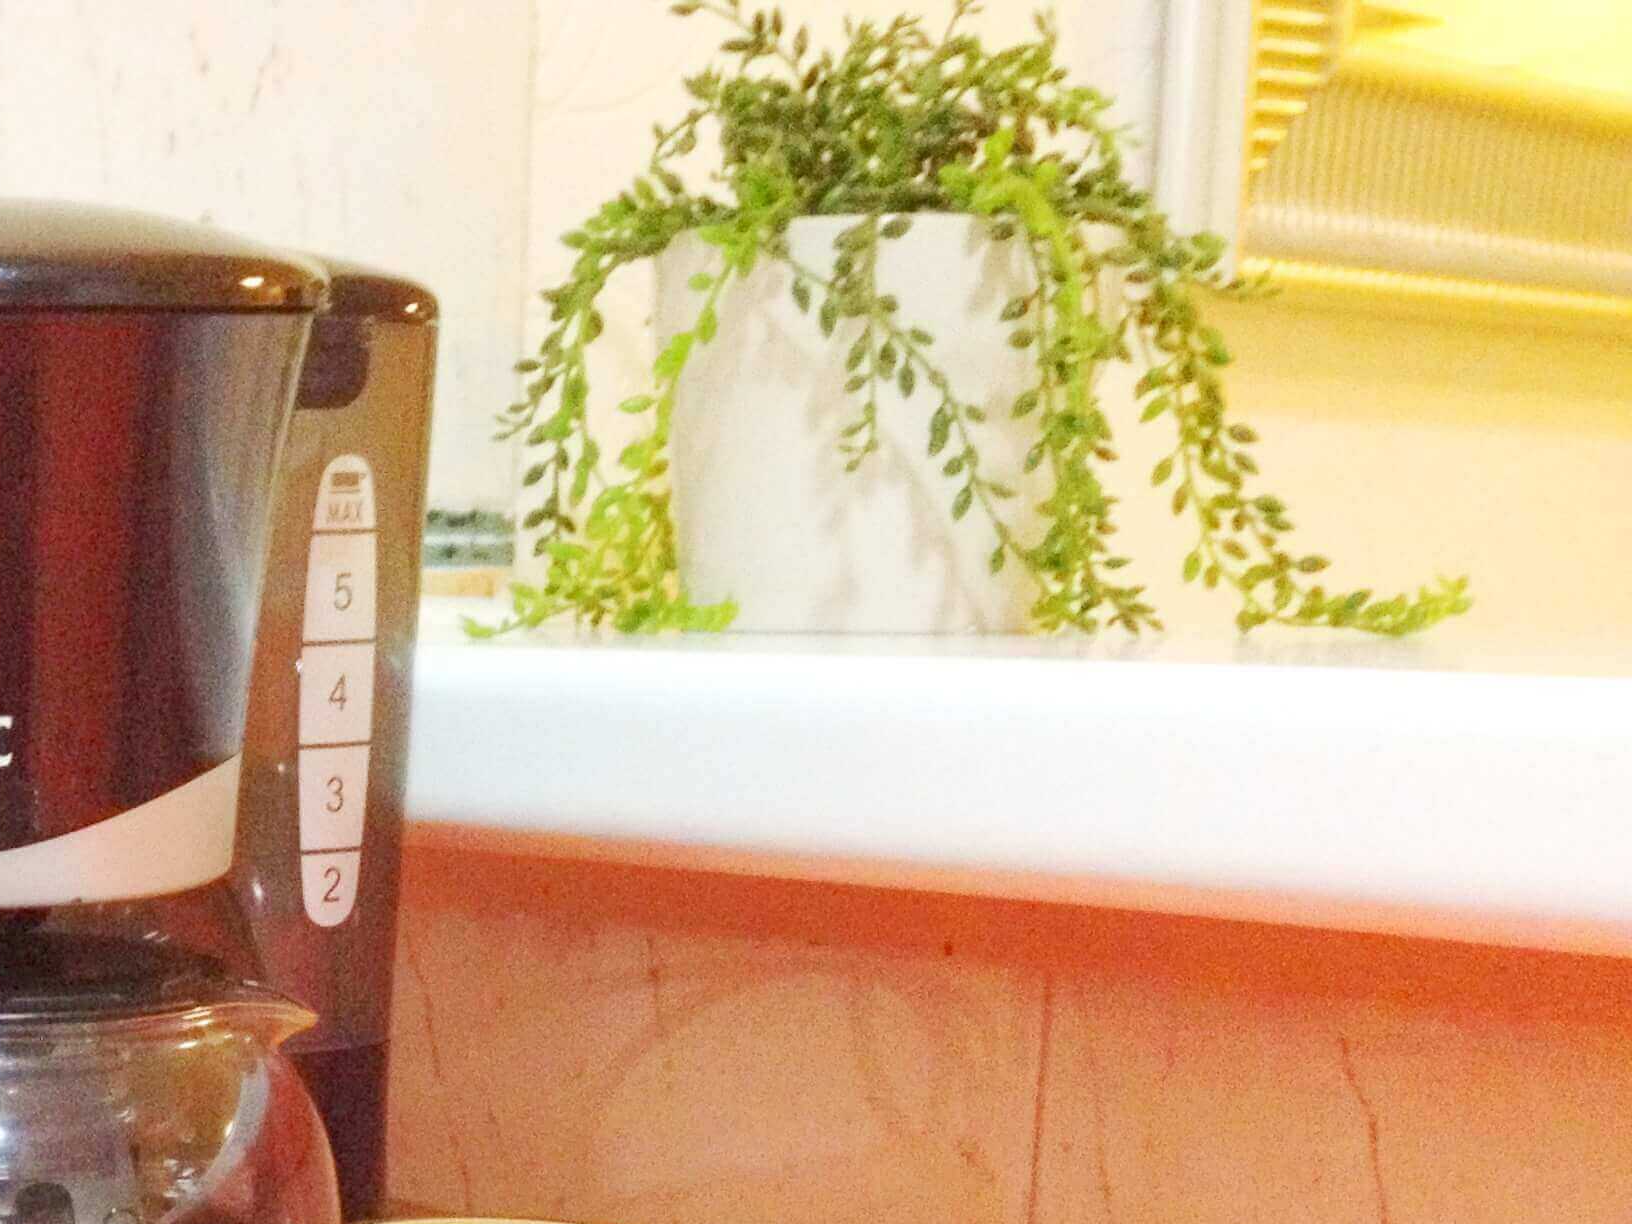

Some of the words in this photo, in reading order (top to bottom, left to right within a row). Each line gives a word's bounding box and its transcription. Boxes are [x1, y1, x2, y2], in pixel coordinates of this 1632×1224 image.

[325, 501, 365, 524] MAX
[332, 572, 354, 612] 5
[327, 673, 348, 711] 4
[325, 776, 345, 813] 3
[322, 867, 341, 903] 2
